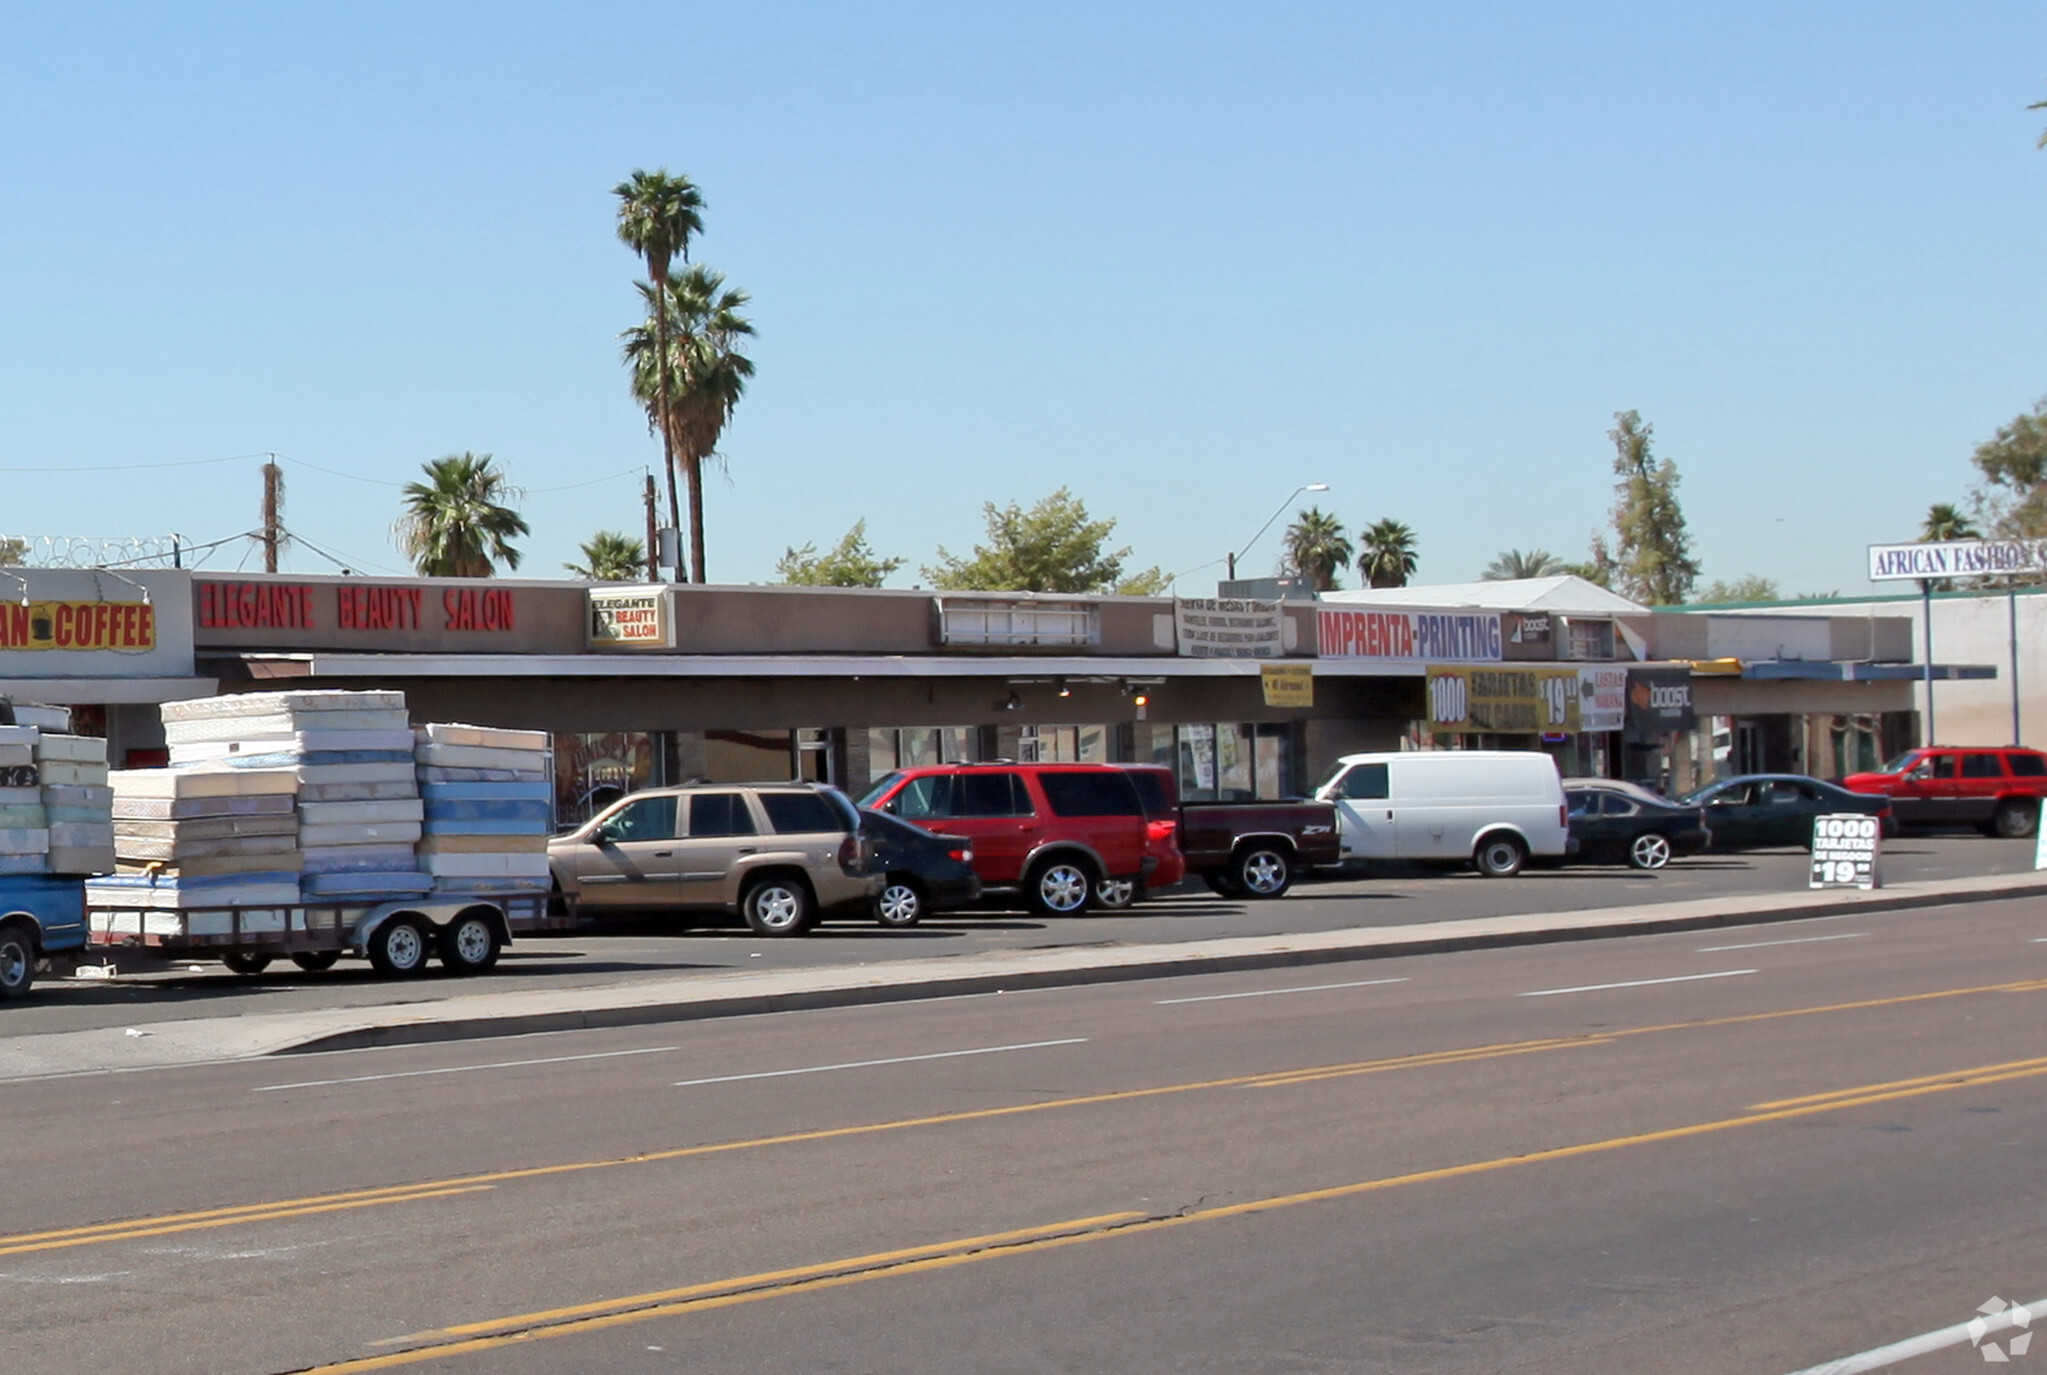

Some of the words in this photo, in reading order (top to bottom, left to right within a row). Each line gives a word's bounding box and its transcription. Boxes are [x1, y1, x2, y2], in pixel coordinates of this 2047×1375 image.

[1876, 548, 1947, 575] AFRICAN
[201, 583, 316, 629] ELEGANTE
[337, 587, 424, 629] BEAUTY
[444, 588, 516, 630] SALON
[592, 598, 656, 609] ELEGANTE
[55, 604, 151, 647] COFFEE
[615, 610, 656, 623] BEAUTY
[623, 624, 657, 637] SALON
[1430, 676, 1466, 723] 1000
[1650, 681, 1691, 708] boost
[1816, 819, 1875, 838] 1000
[1815, 838, 1875, 850] TARJETAS
